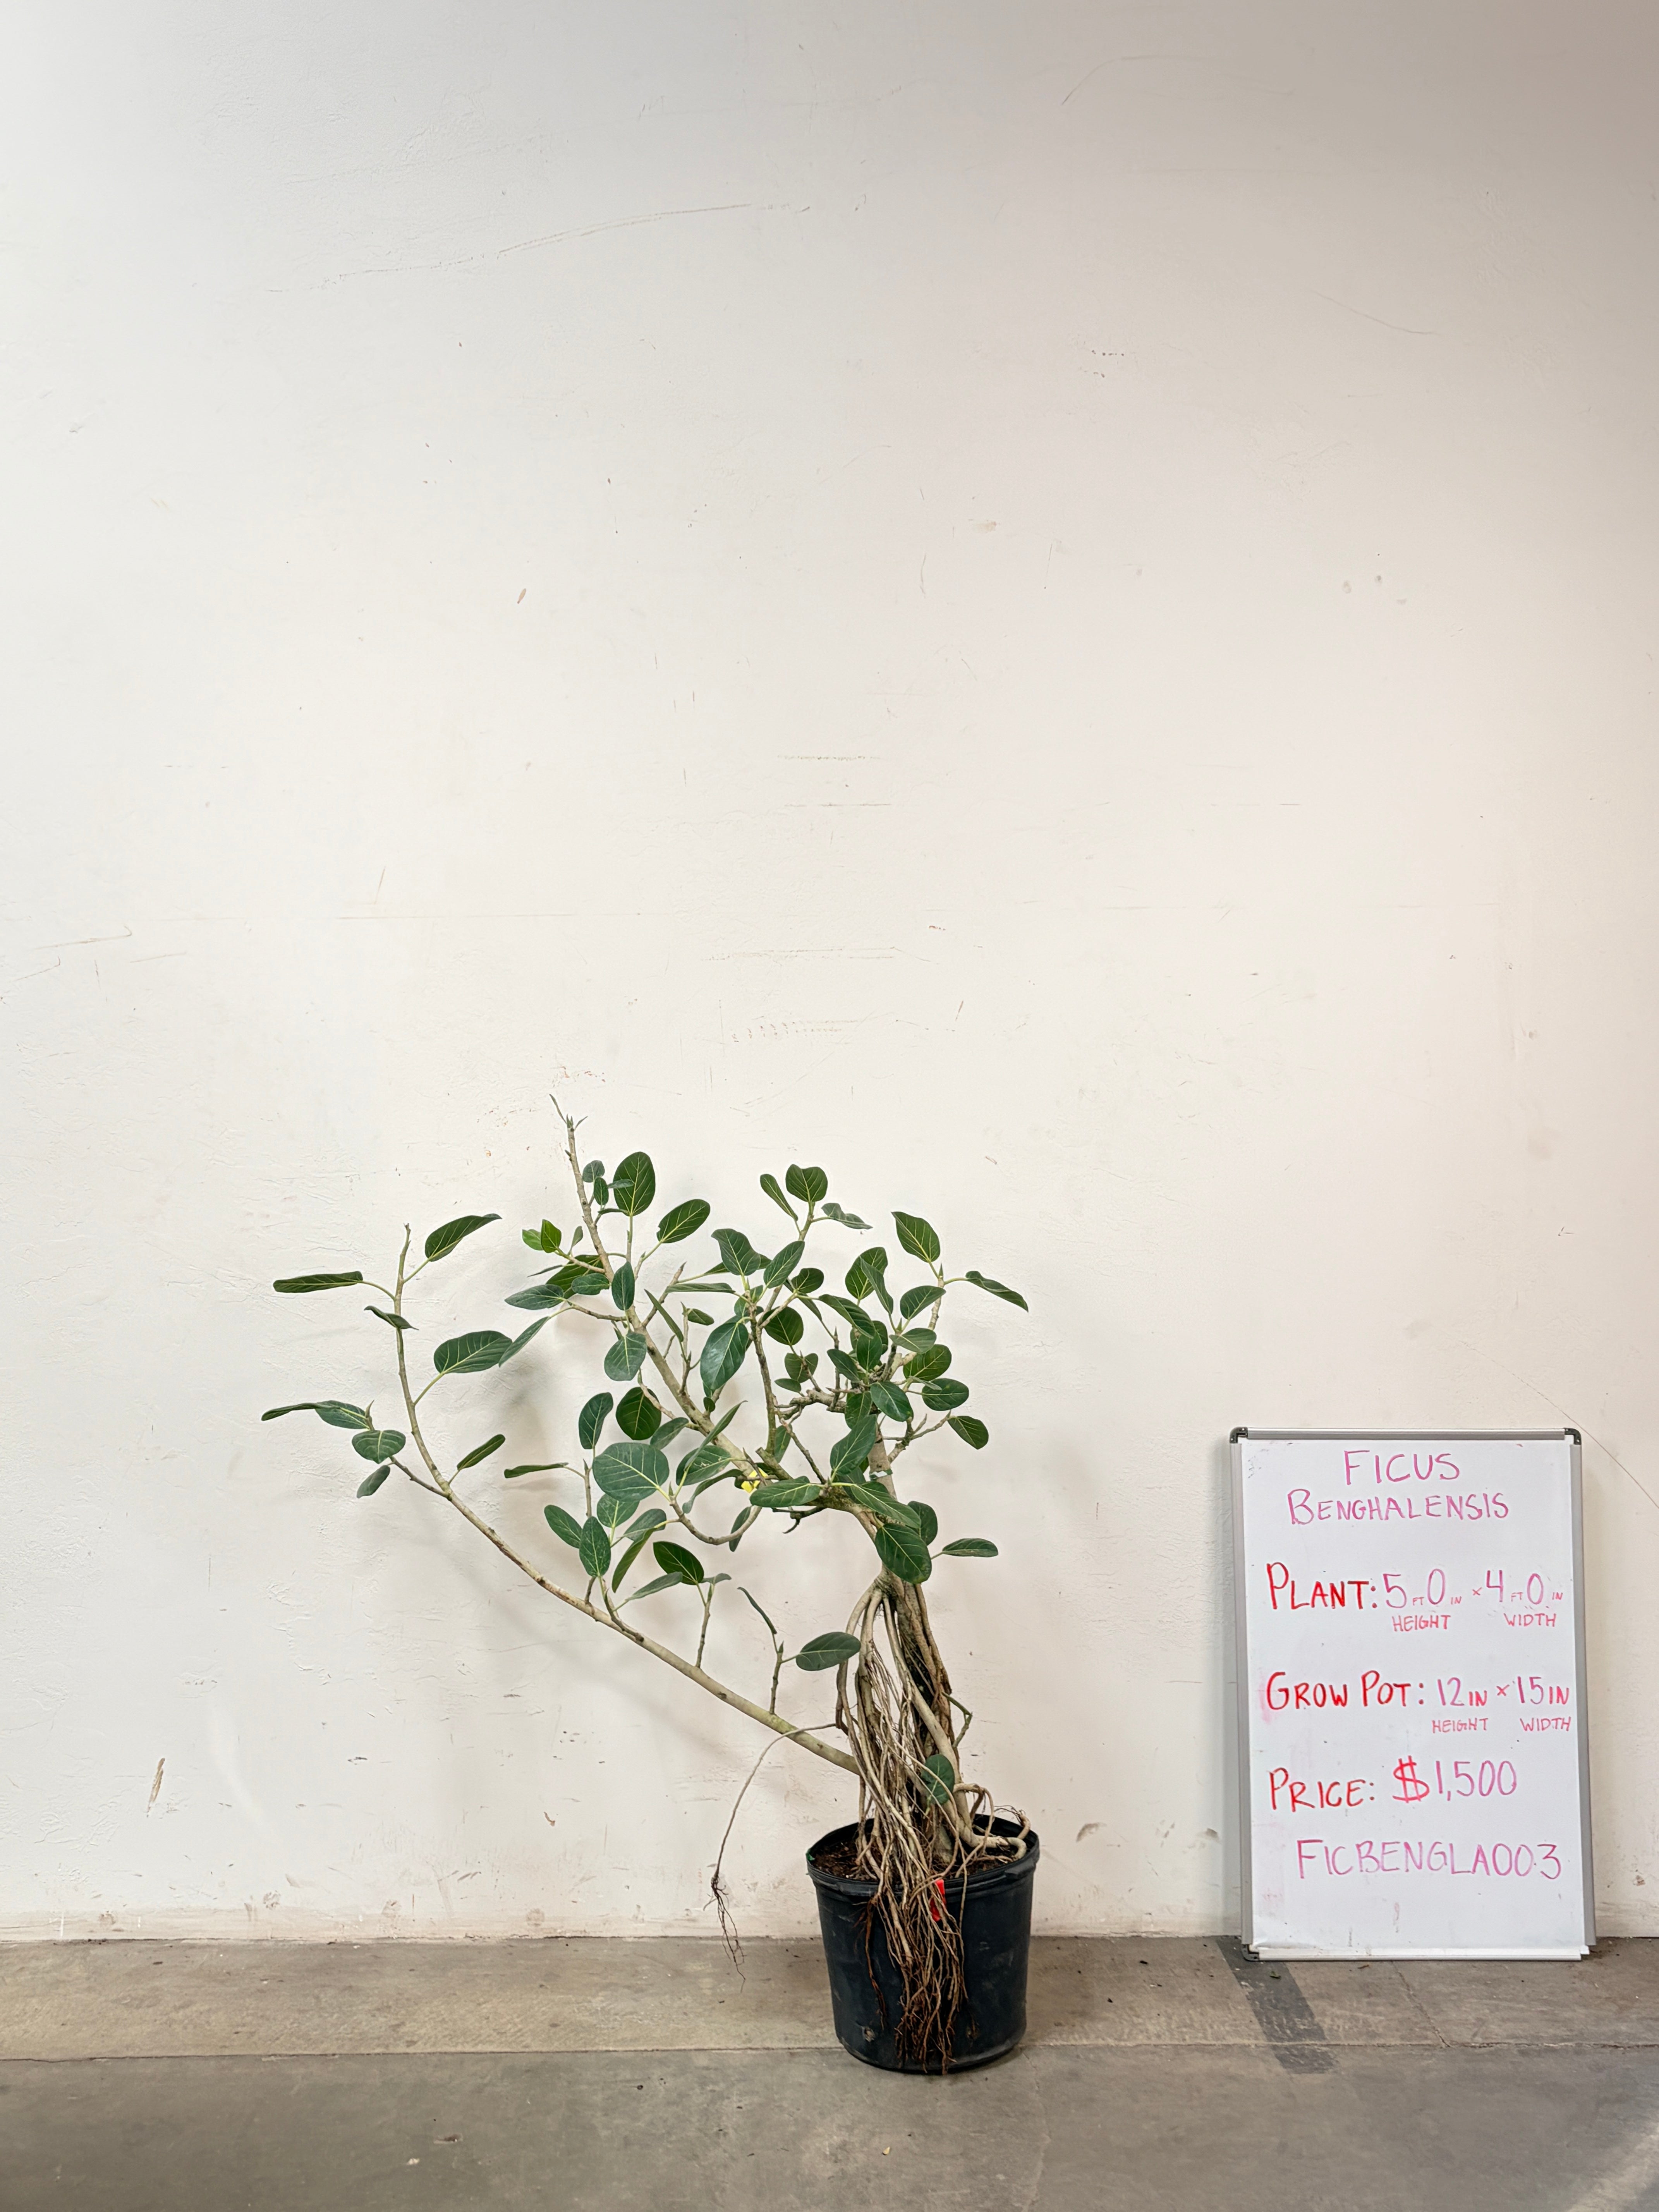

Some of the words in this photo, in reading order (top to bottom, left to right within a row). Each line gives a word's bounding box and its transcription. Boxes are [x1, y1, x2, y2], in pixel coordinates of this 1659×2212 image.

[1344, 1450, 1460, 1485] FICUS
[1287, 1489, 1509, 1525] BENGHALENSIS
[1266, 1562, 1377, 1609] PLANT:
[1392, 1614, 1451, 1632] HEIGHT
[1504, 1613, 1556, 1627] WIDTH
[1266, 1671, 1348, 1710] GROW
[1361, 1670, 1424, 1707] POT:
[1432, 1718, 1487, 1733] HEIGHT
[1520, 1717, 1571, 1732] WIDTH
[1269, 1767, 1374, 1813] PRICE:
[1392, 1755, 1517, 1804] $1,500
[1297, 1839, 1561, 1880] FICBENGLA003
